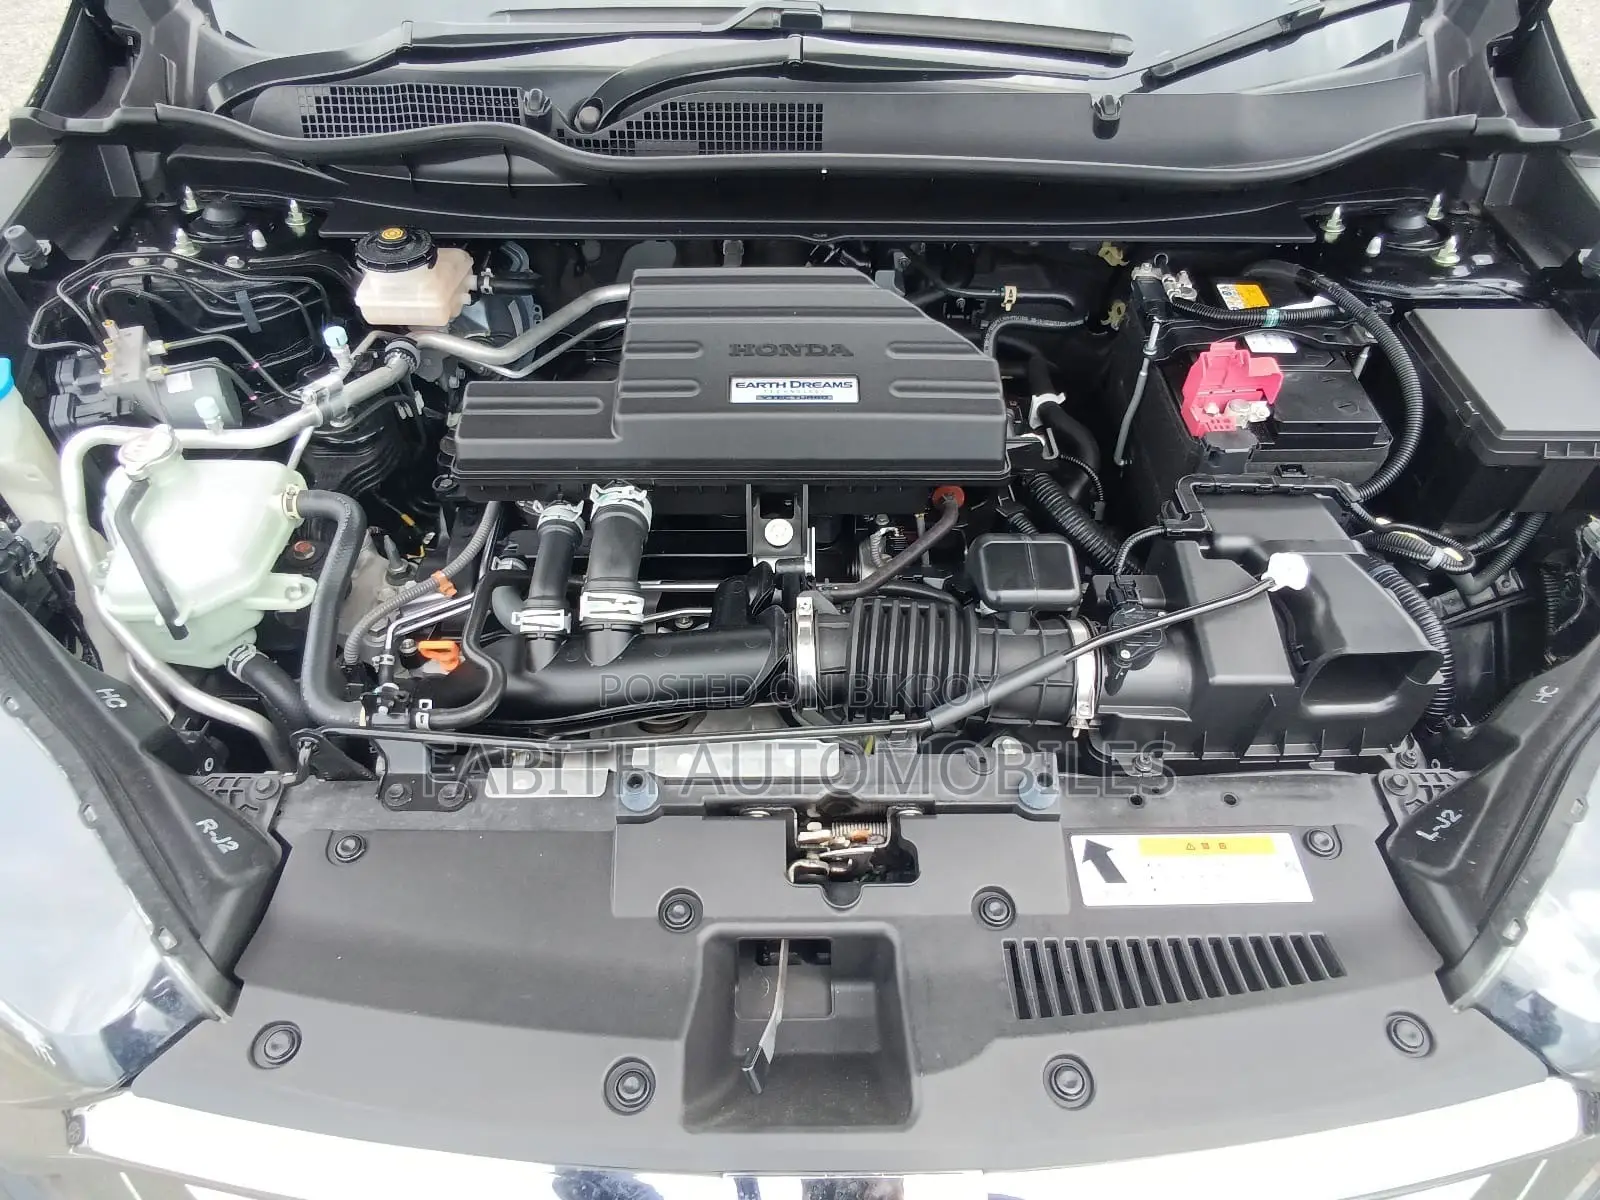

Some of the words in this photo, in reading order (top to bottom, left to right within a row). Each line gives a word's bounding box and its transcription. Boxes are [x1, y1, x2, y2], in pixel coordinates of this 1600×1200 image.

[728, 343, 854, 357] HONDA
[735, 381, 786, 389] EARTH
[789, 380, 853, 389] DREAMS
[1530, 685, 1560, 704] HC
